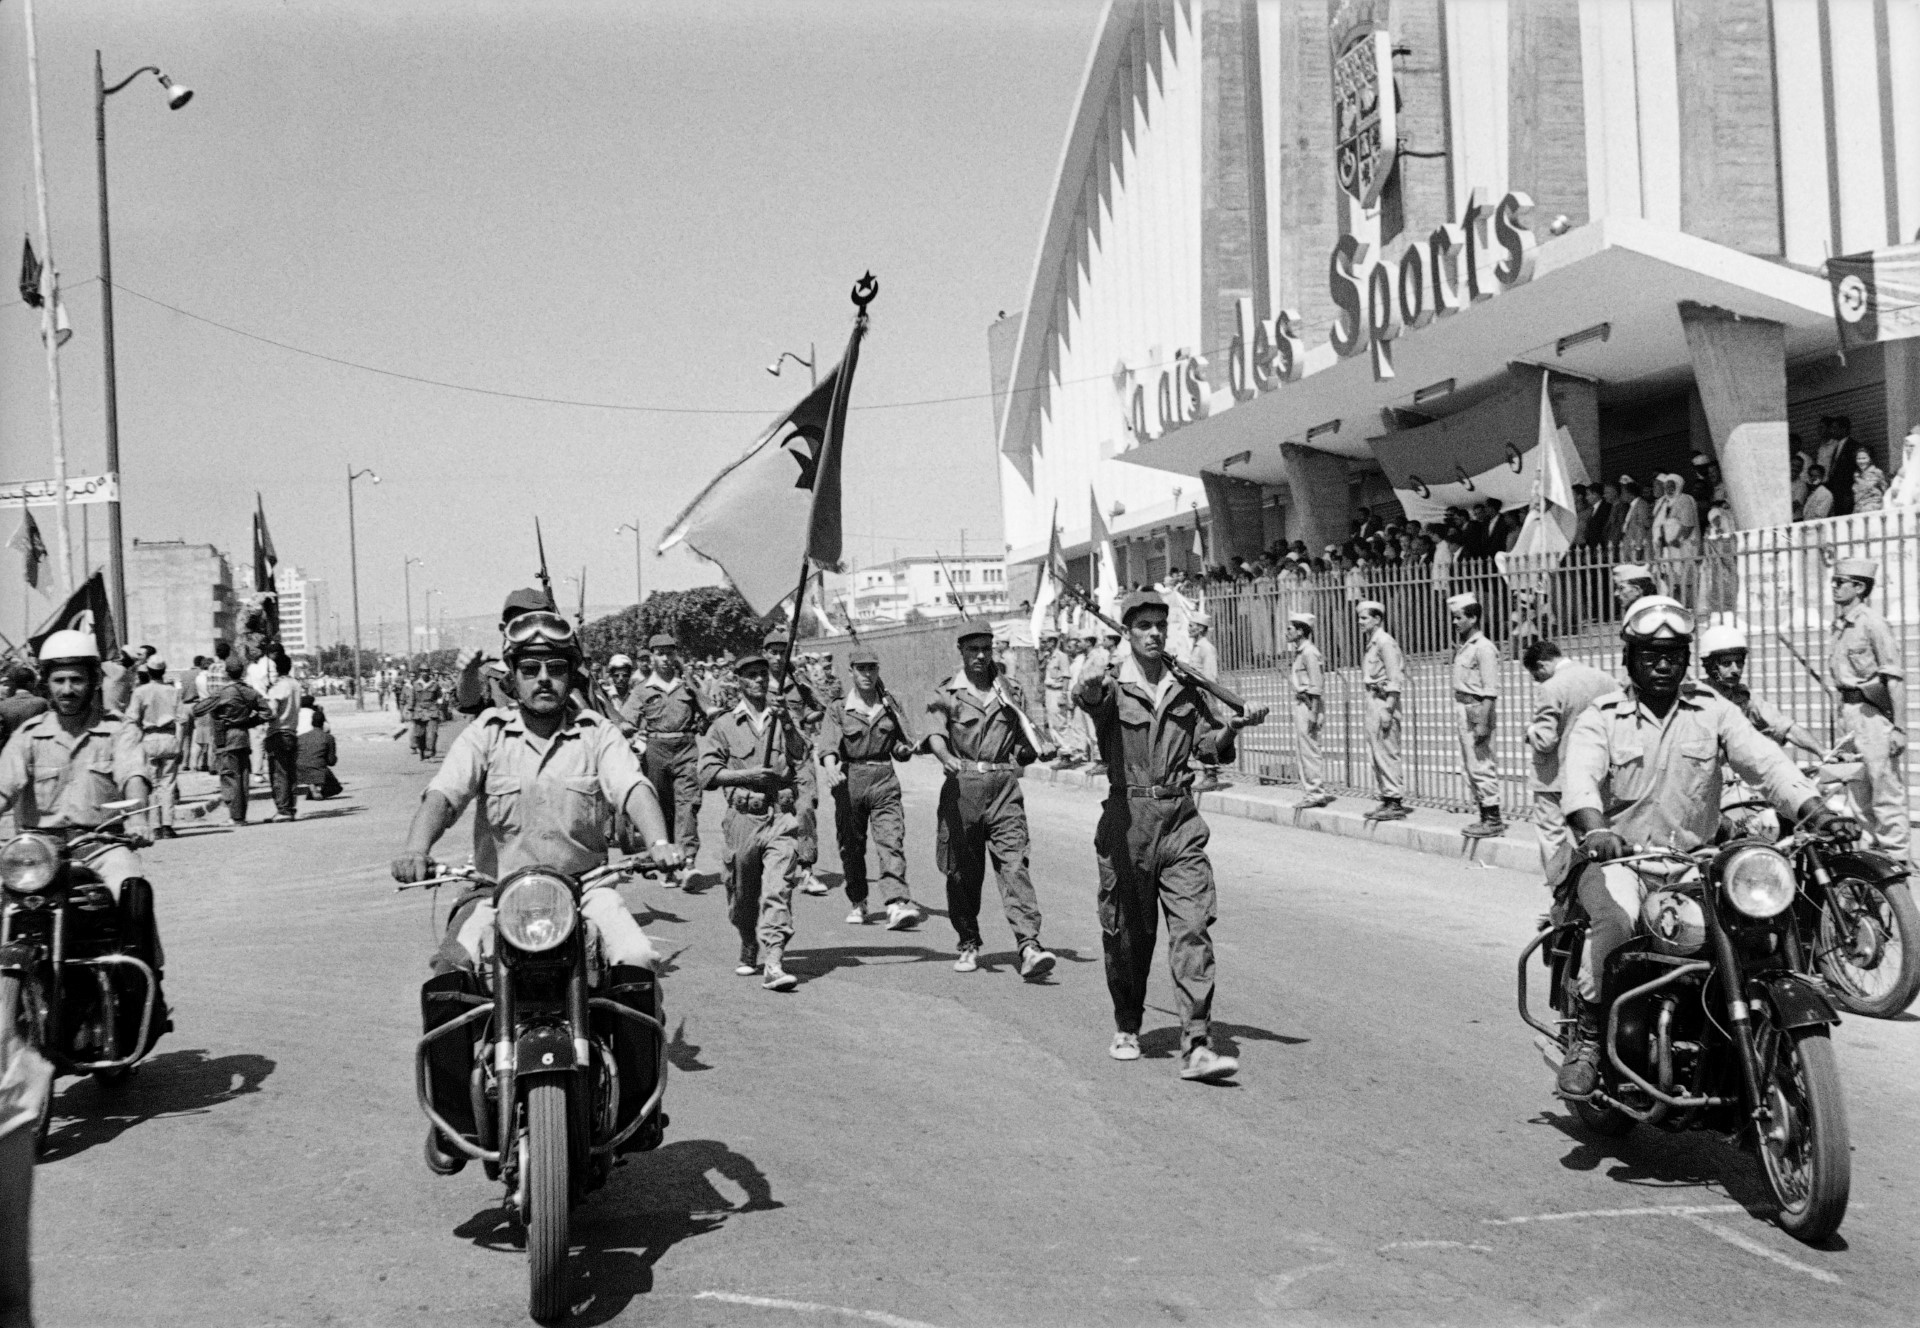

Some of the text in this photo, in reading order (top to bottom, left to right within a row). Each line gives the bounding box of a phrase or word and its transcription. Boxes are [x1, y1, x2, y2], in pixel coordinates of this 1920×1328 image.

[1112, 187, 1536, 451] aais des Sports
[541, 1052, 554, 1065] 6
